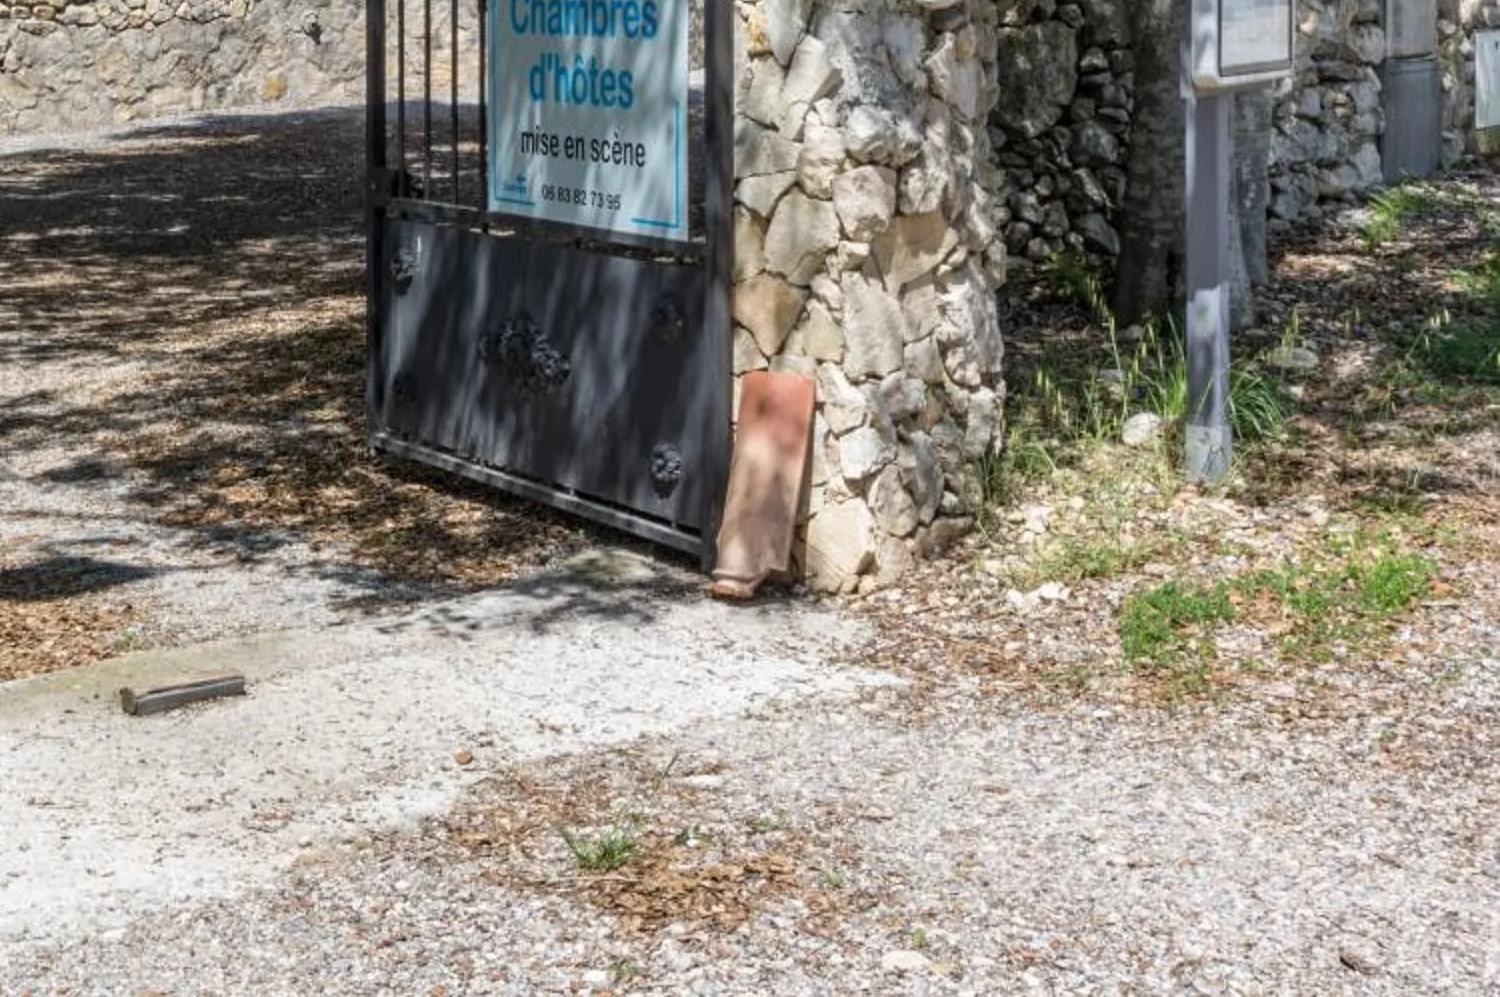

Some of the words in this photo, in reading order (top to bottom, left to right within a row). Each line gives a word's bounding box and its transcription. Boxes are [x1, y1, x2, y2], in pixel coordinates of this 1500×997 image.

[530, 52, 634, 109] d'hôtes
[521, 125, 559, 157] mise
[564, 135, 585, 161] en
[591, 131, 645, 167] scène
[573, 188, 587, 206] 82
